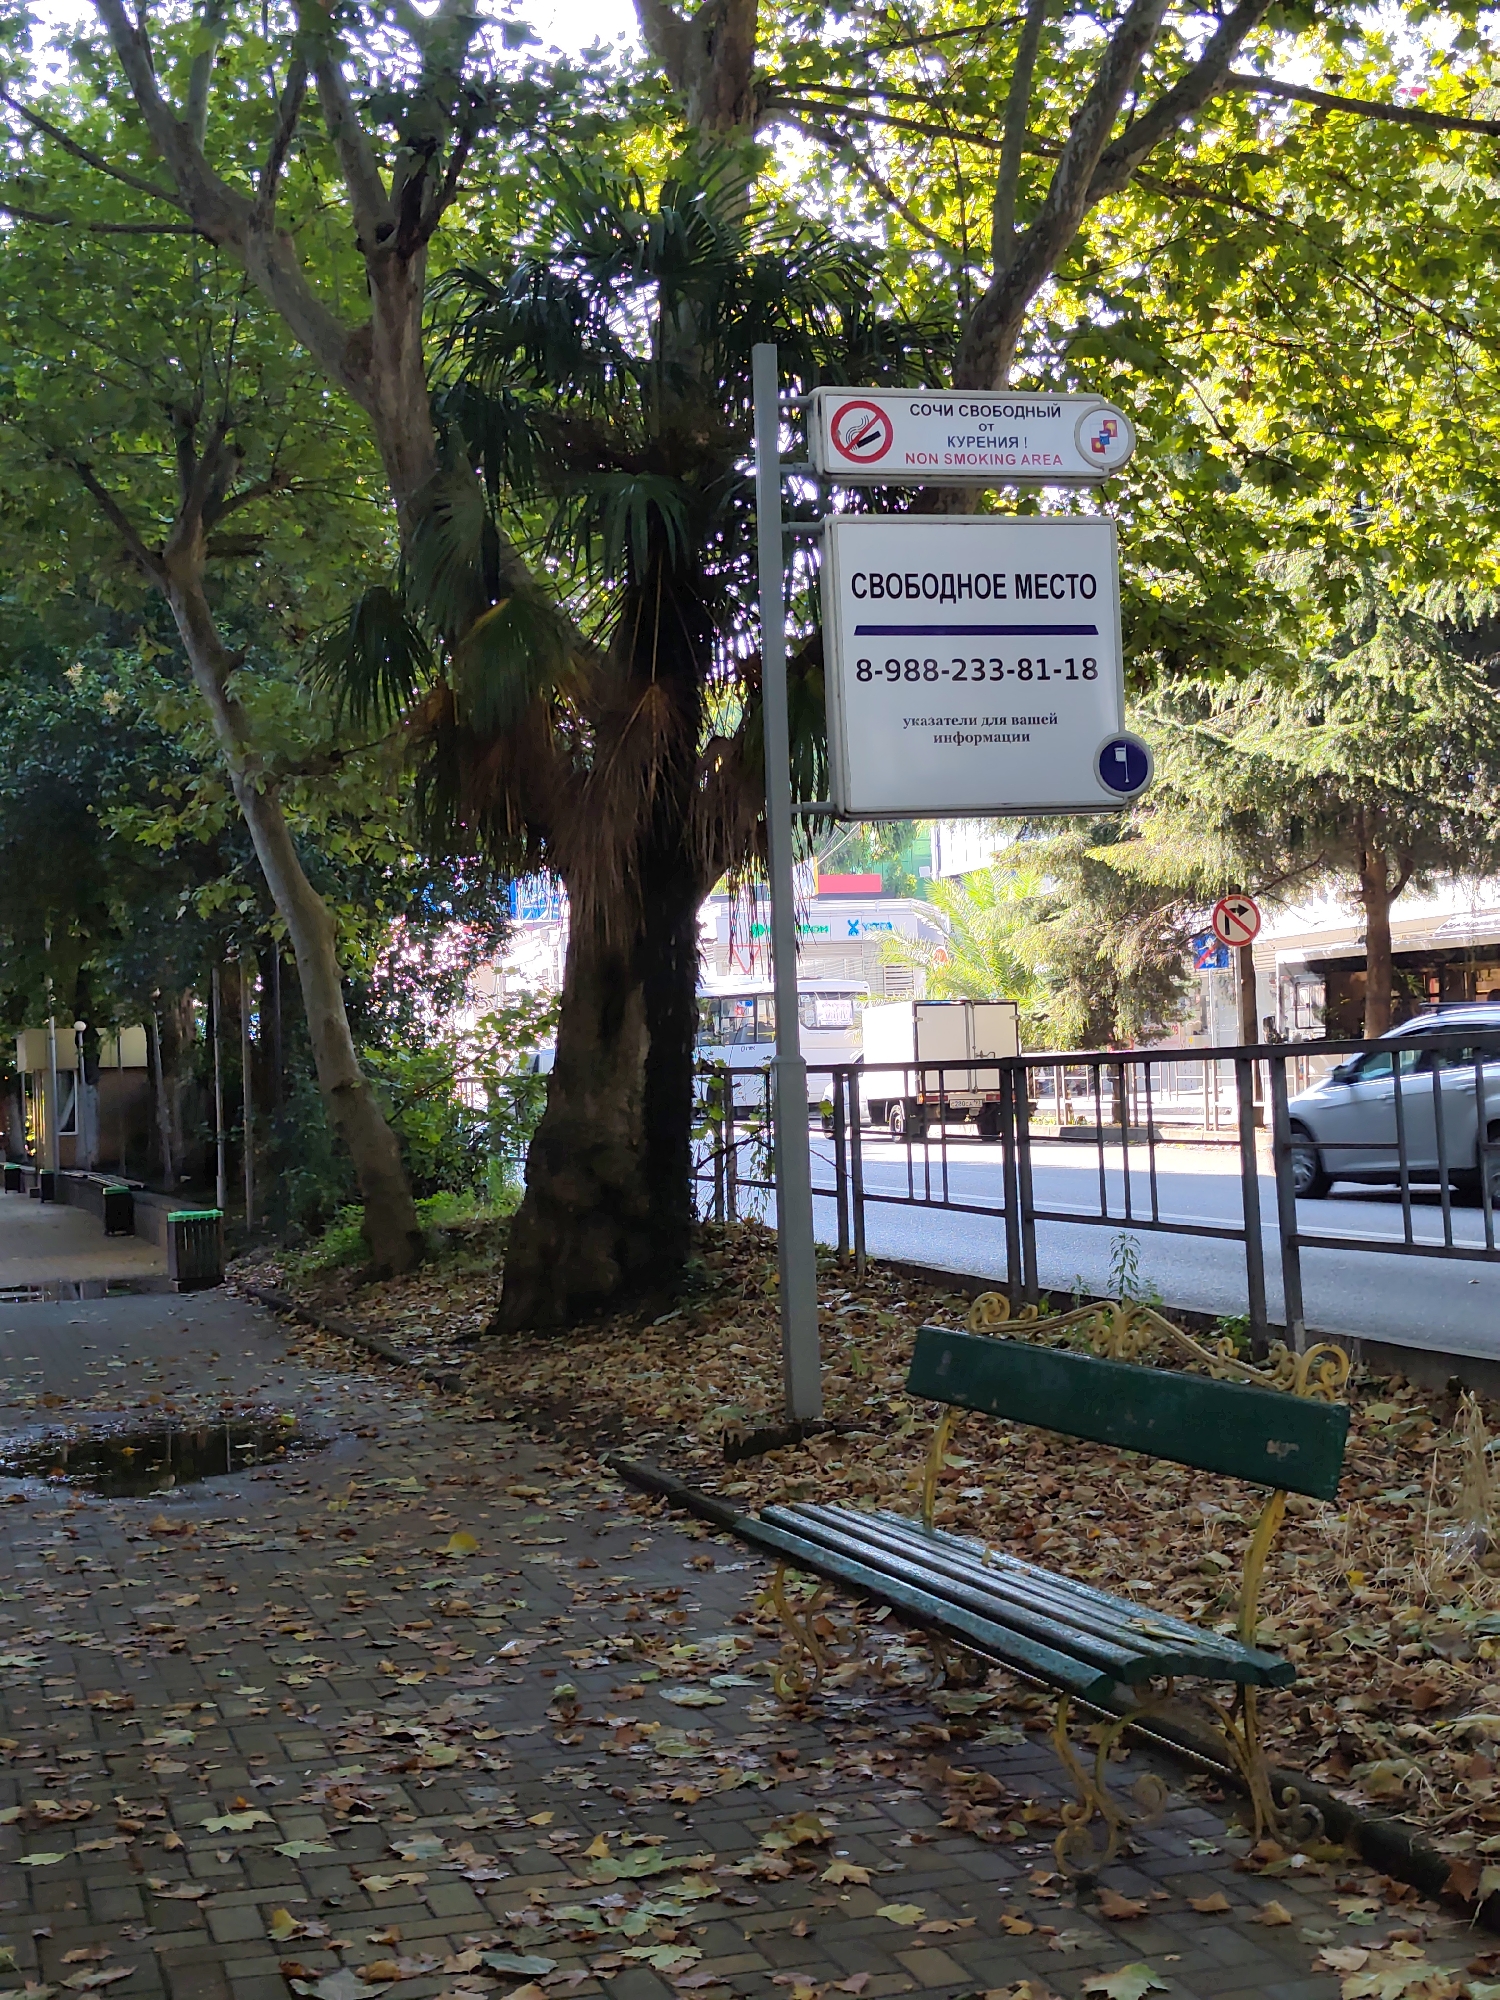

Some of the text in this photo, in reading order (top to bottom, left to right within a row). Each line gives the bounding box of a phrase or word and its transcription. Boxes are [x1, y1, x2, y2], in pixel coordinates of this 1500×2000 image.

[909, 402, 1062, 419] СОЧИ СВОБОДНЫЙ
[947, 435, 1019, 449] КУРЕНИЯ
[905, 452, 1063, 466] NON SMOKING AREA
[851, 572, 1098, 605] СВОБОДНОЕ МЕСТО
[855, 657, 1099, 682] 8-988-233-81-18
[902, 712, 1059, 730] указатели для вашей
[933, 730, 1031, 747] информации
